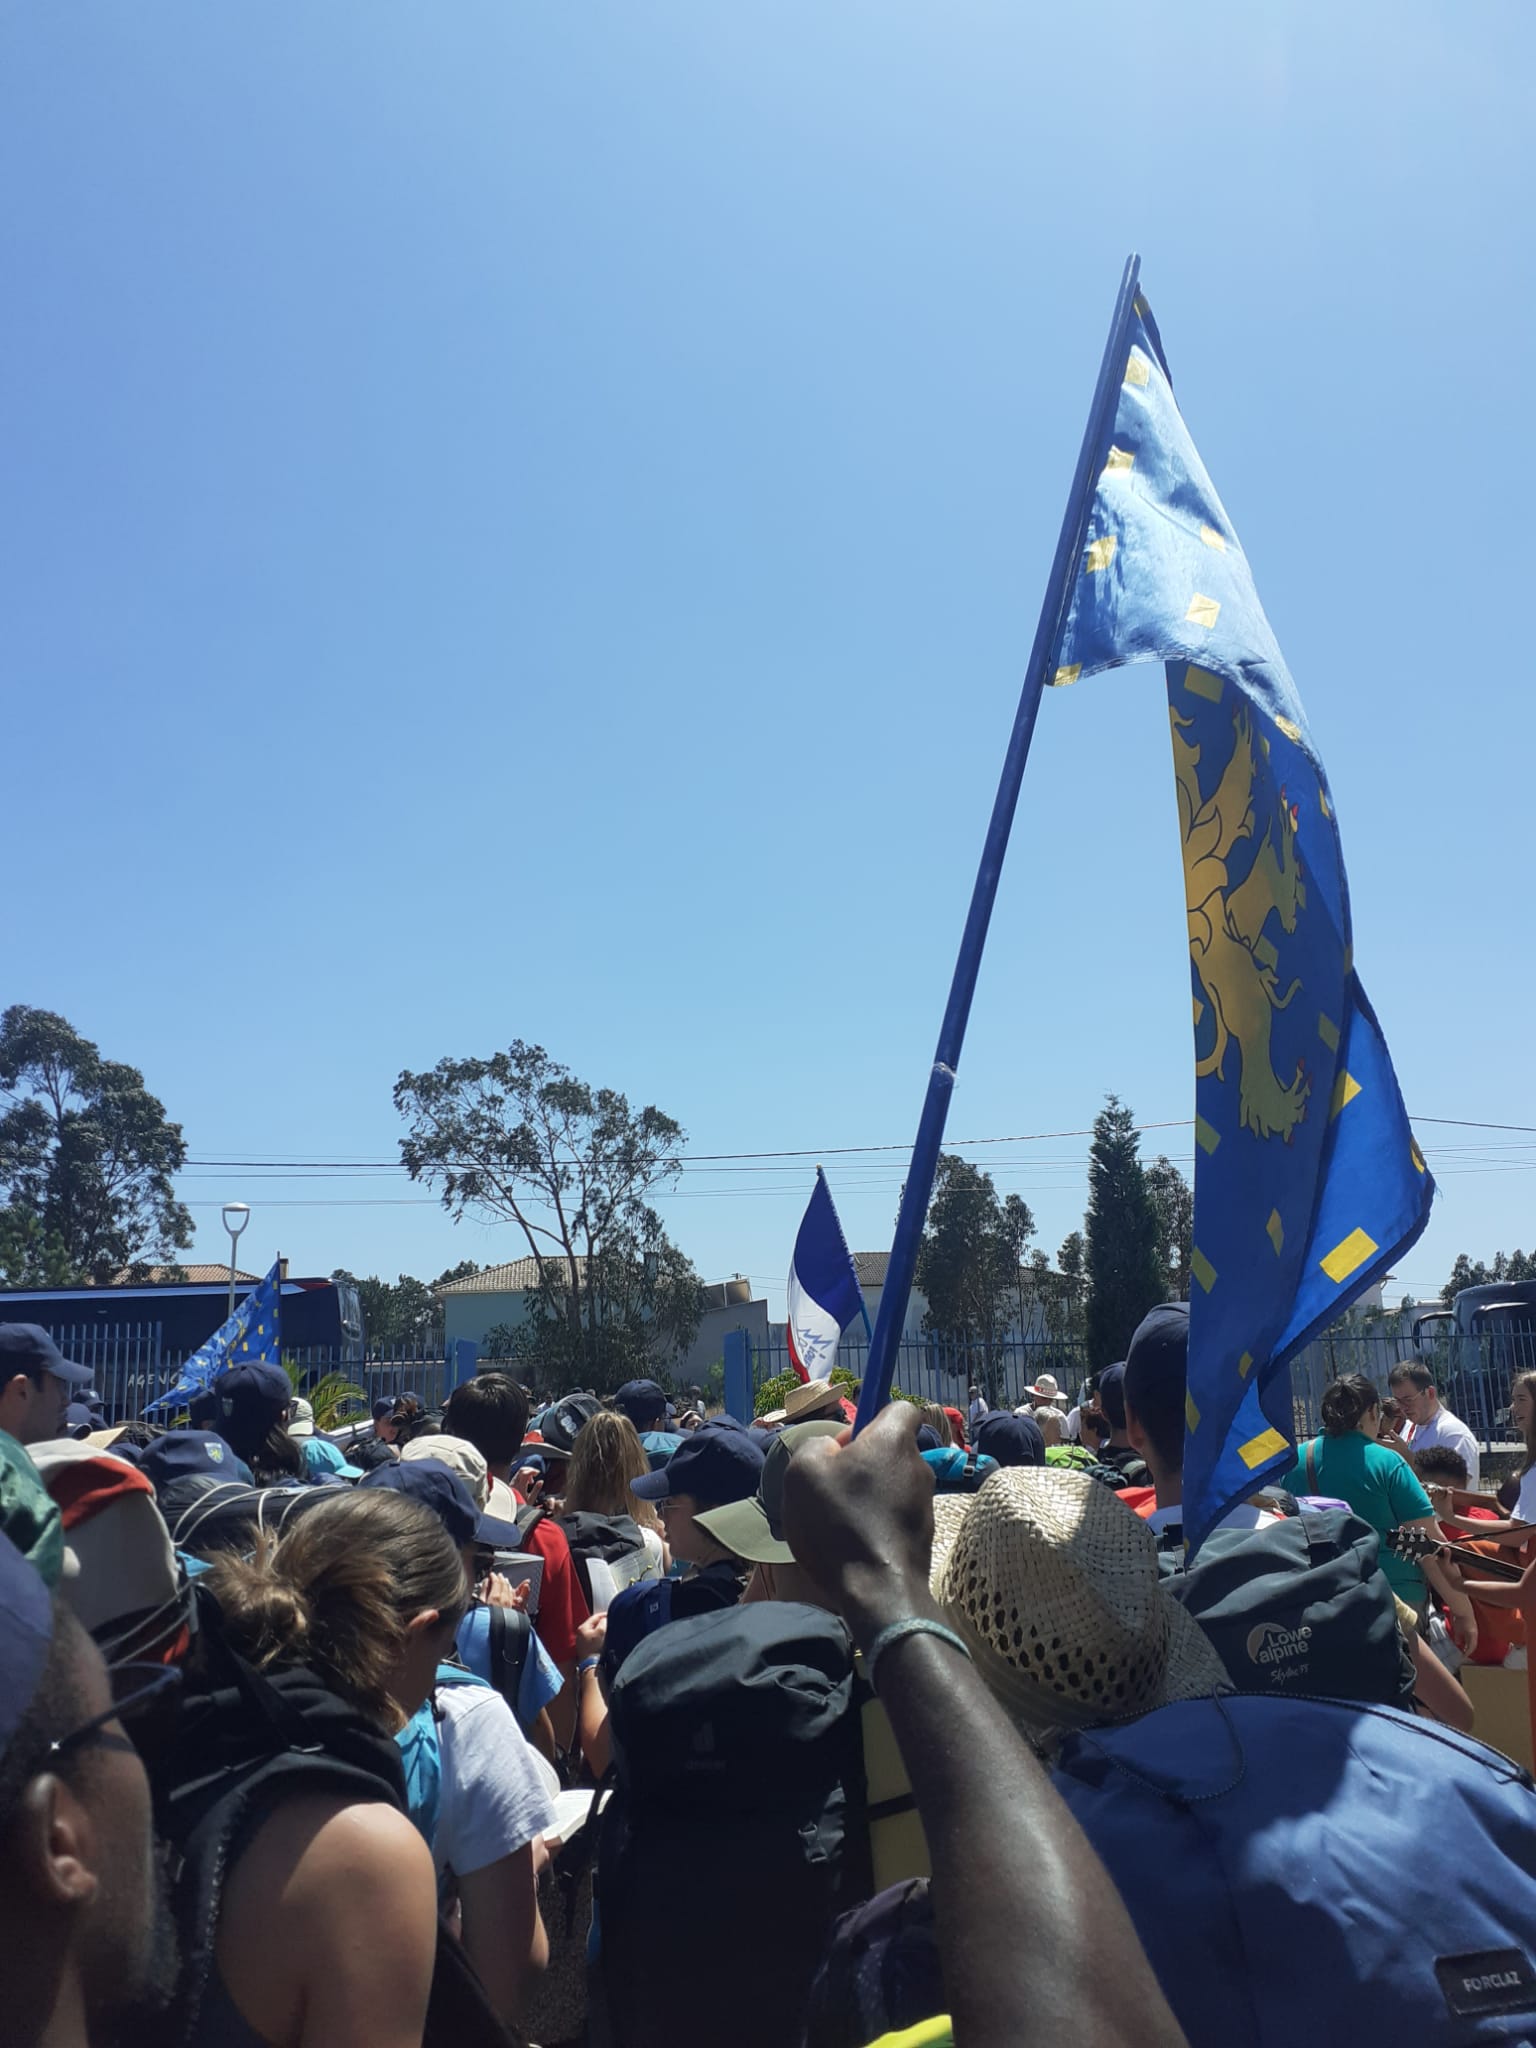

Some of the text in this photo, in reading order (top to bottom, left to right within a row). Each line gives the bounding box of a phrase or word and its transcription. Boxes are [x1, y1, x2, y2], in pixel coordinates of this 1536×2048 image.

[128, 1370, 180, 1389] AGENC
[1267, 1626, 1312, 1647] Lowe
[1259, 1640, 1309, 1664] alpine
[1462, 1970, 1522, 1992] FORCLAZ
